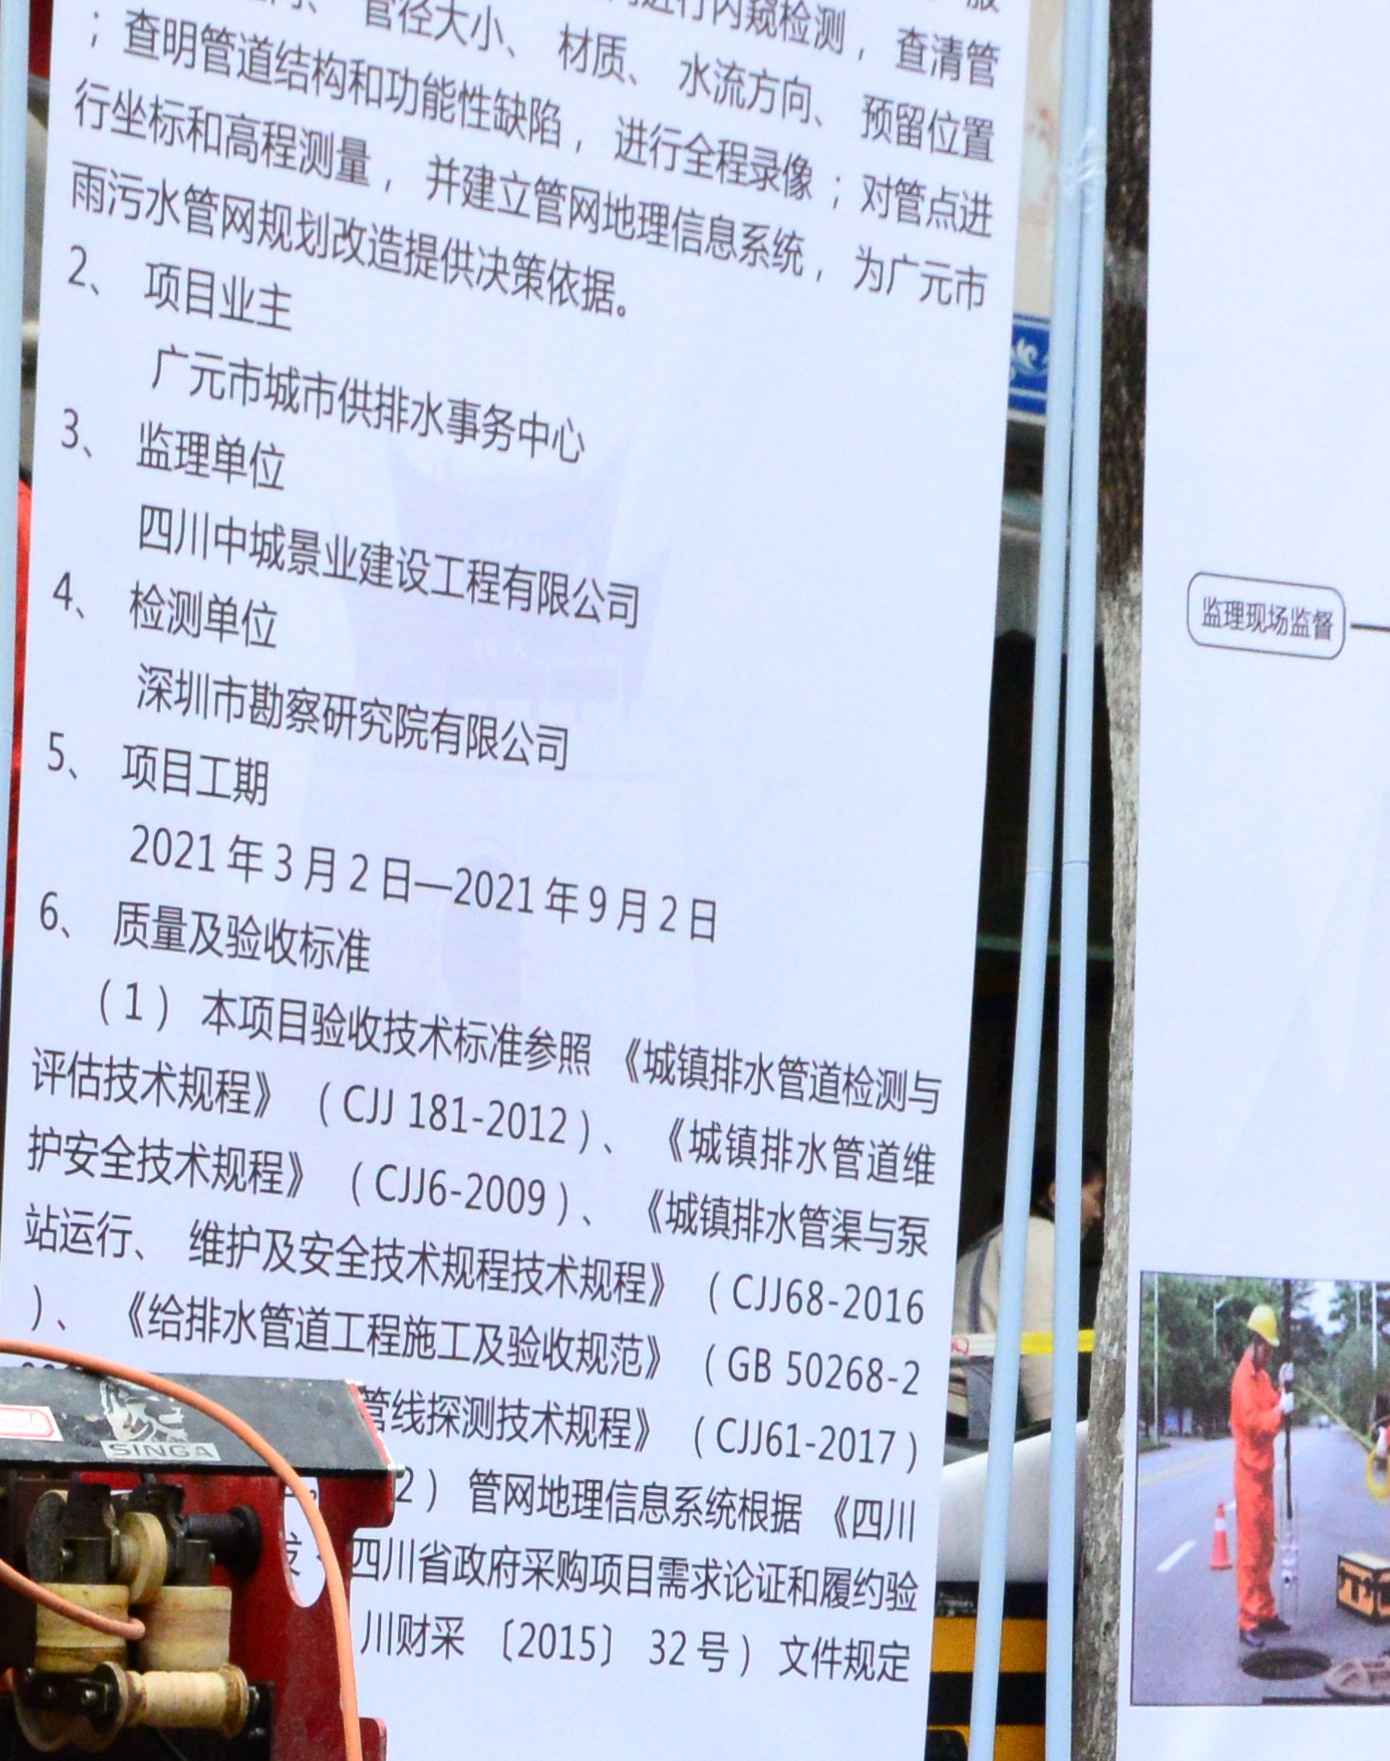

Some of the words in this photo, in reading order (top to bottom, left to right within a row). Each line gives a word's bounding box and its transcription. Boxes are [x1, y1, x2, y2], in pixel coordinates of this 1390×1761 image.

[152, 344, 585, 463] 广元市城市供排水事务中心
[139, 504, 639, 629] 四川中城景业建设工程有限公司
[1202, 596, 1333, 640] 监理现场监督
[137, 663, 568, 771] 深圳市勘察研究院有限公司
[109, 1442, 214, 1458] SINGA
